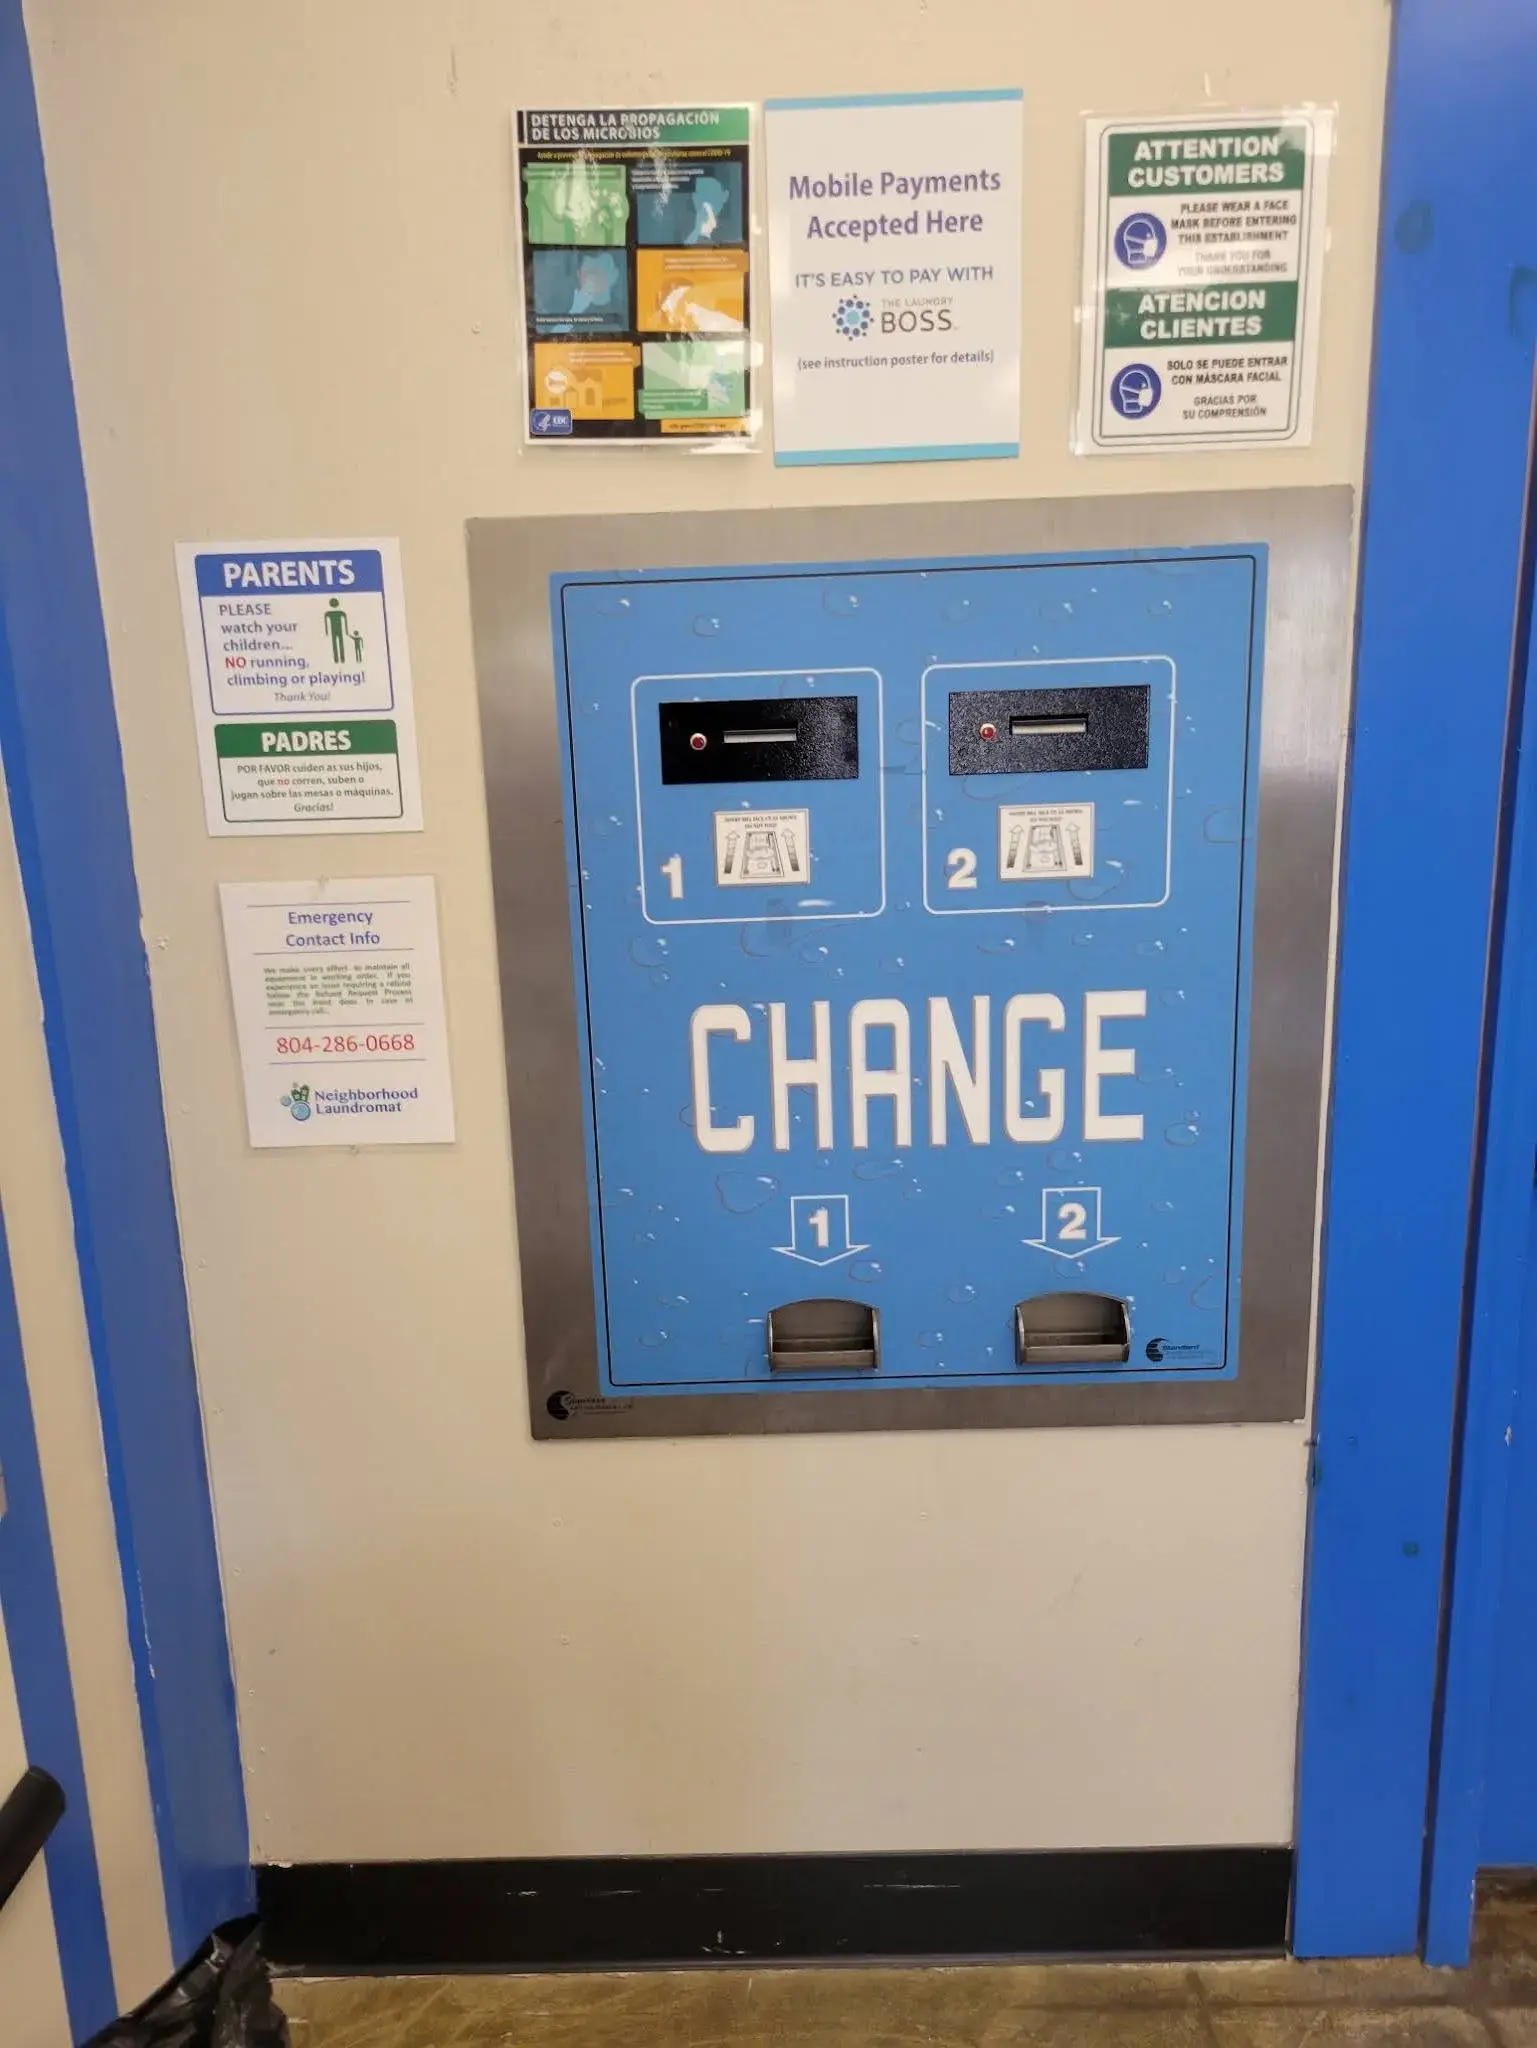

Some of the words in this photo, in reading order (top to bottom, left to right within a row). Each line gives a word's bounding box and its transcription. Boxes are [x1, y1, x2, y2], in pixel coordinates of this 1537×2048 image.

[531, 113, 595, 127] DETENGA
[599, 113, 617, 126] LA
[621, 110, 720, 126] PROPAGACIÓN
[532, 128, 551, 140] DE
[554, 128, 579, 140] LOS
[583, 126, 661, 140] MICROBIOS
[1134, 136, 1279, 161] ATTENTION
[1127, 162, 1284, 188] CUSTOMERS
[789, 172, 873, 200] Mobile
[881, 169, 1001, 200] Payments
[1180, 202, 1218, 214] PLEASE
[1222, 201, 1250, 212] WEAR
[1254, 201, 1260, 211] A
[1264, 200, 1289, 211] FACE
[807, 210, 918, 242] Accepted
[926, 210, 983, 235] Here
[1171, 218, 1199, 229] MASK
[1203, 217, 1243, 228] BEFORE
[1246, 215, 1297, 227] ENTERING
[1178, 233, 1201, 244] THIS
[1204, 231, 1289, 244] ESTABLISHMENT
[795, 273, 825, 288] IT'S
[831, 271, 874, 287] EASY
[881, 270, 904, 285] TO
[910, 268, 941, 284] PAY
[947, 266, 994, 282] WITH
[881, 298, 902, 308] THE
[905, 296, 953, 307] LAUNDRY
[1137, 289, 1266, 315] ATENCION
[1139, 316, 1262, 340] CLIENTES
[797, 357, 822, 371] (see
[824, 354, 888, 369] instruction
[890, 353, 929, 368] poster
[931, 352, 948, 366] for
[950, 349, 995, 365] details)
[1167, 359, 1193, 371] SOLO
[1196, 359, 1209, 369] SE
[1211, 358, 1244, 369] PUEDE
[1247, 356, 1288, 367] ENTRAR
[1171, 375, 1193, 386] CON
[1195, 371, 1244, 385] MÁSCARA
[1247, 372, 1282, 383] FACIAL
[1194, 395, 1234, 407] GRACIAS
[1237, 394, 1257, 405] POR
[1182, 410, 1196, 420] SU
[1198, 406, 1266, 419] COMPRENSIÓN
[223, 559, 356, 588] PARENTS
[219, 603, 272, 617] PLEASE
[221, 621, 263, 634] watch
[266, 622, 298, 636] your
[223, 638, 293, 652] children...
[225, 657, 247, 669] NO
[250, 656, 310, 670] running,
[227, 672, 288, 688] climbing
[291, 674, 305, 685] or
[309, 671, 366, 686] playing!
[274, 691, 306, 702] Thank
[307, 691, 331, 702] You!
[261, 729, 352, 753] PADRES
[237, 765, 257, 774] POR
[259, 764, 291, 773] FAVOR
[292, 762, 325, 773] cuiden
[338, 764, 354, 772] sus
[257, 779, 275, 788] que
[277, 778, 290, 786] no
[327, 775, 356, 785] suben
[231, 790, 259, 801] jugan
[260, 789, 287, 799] sobre
[288, 789, 302, 798] las
[304, 790, 334, 798] mesas
[293, 802, 334, 813] Gracias!
[947, 847, 978, 889] 2
[661, 857, 684, 899] 1
[287, 910, 373, 927] Emergency
[285, 933, 344, 947] Contact
[349, 931, 380, 945] Info
[276, 1033, 415, 1054] 804-286-0668
[690, 989, 1147, 1153] CHANGE
[314, 1087, 418, 1103] Neighborhood
[316, 1102, 402, 1115] Laundromat
[808, 1206, 830, 1248] 1
[1058, 1202, 1087, 1240] 2
